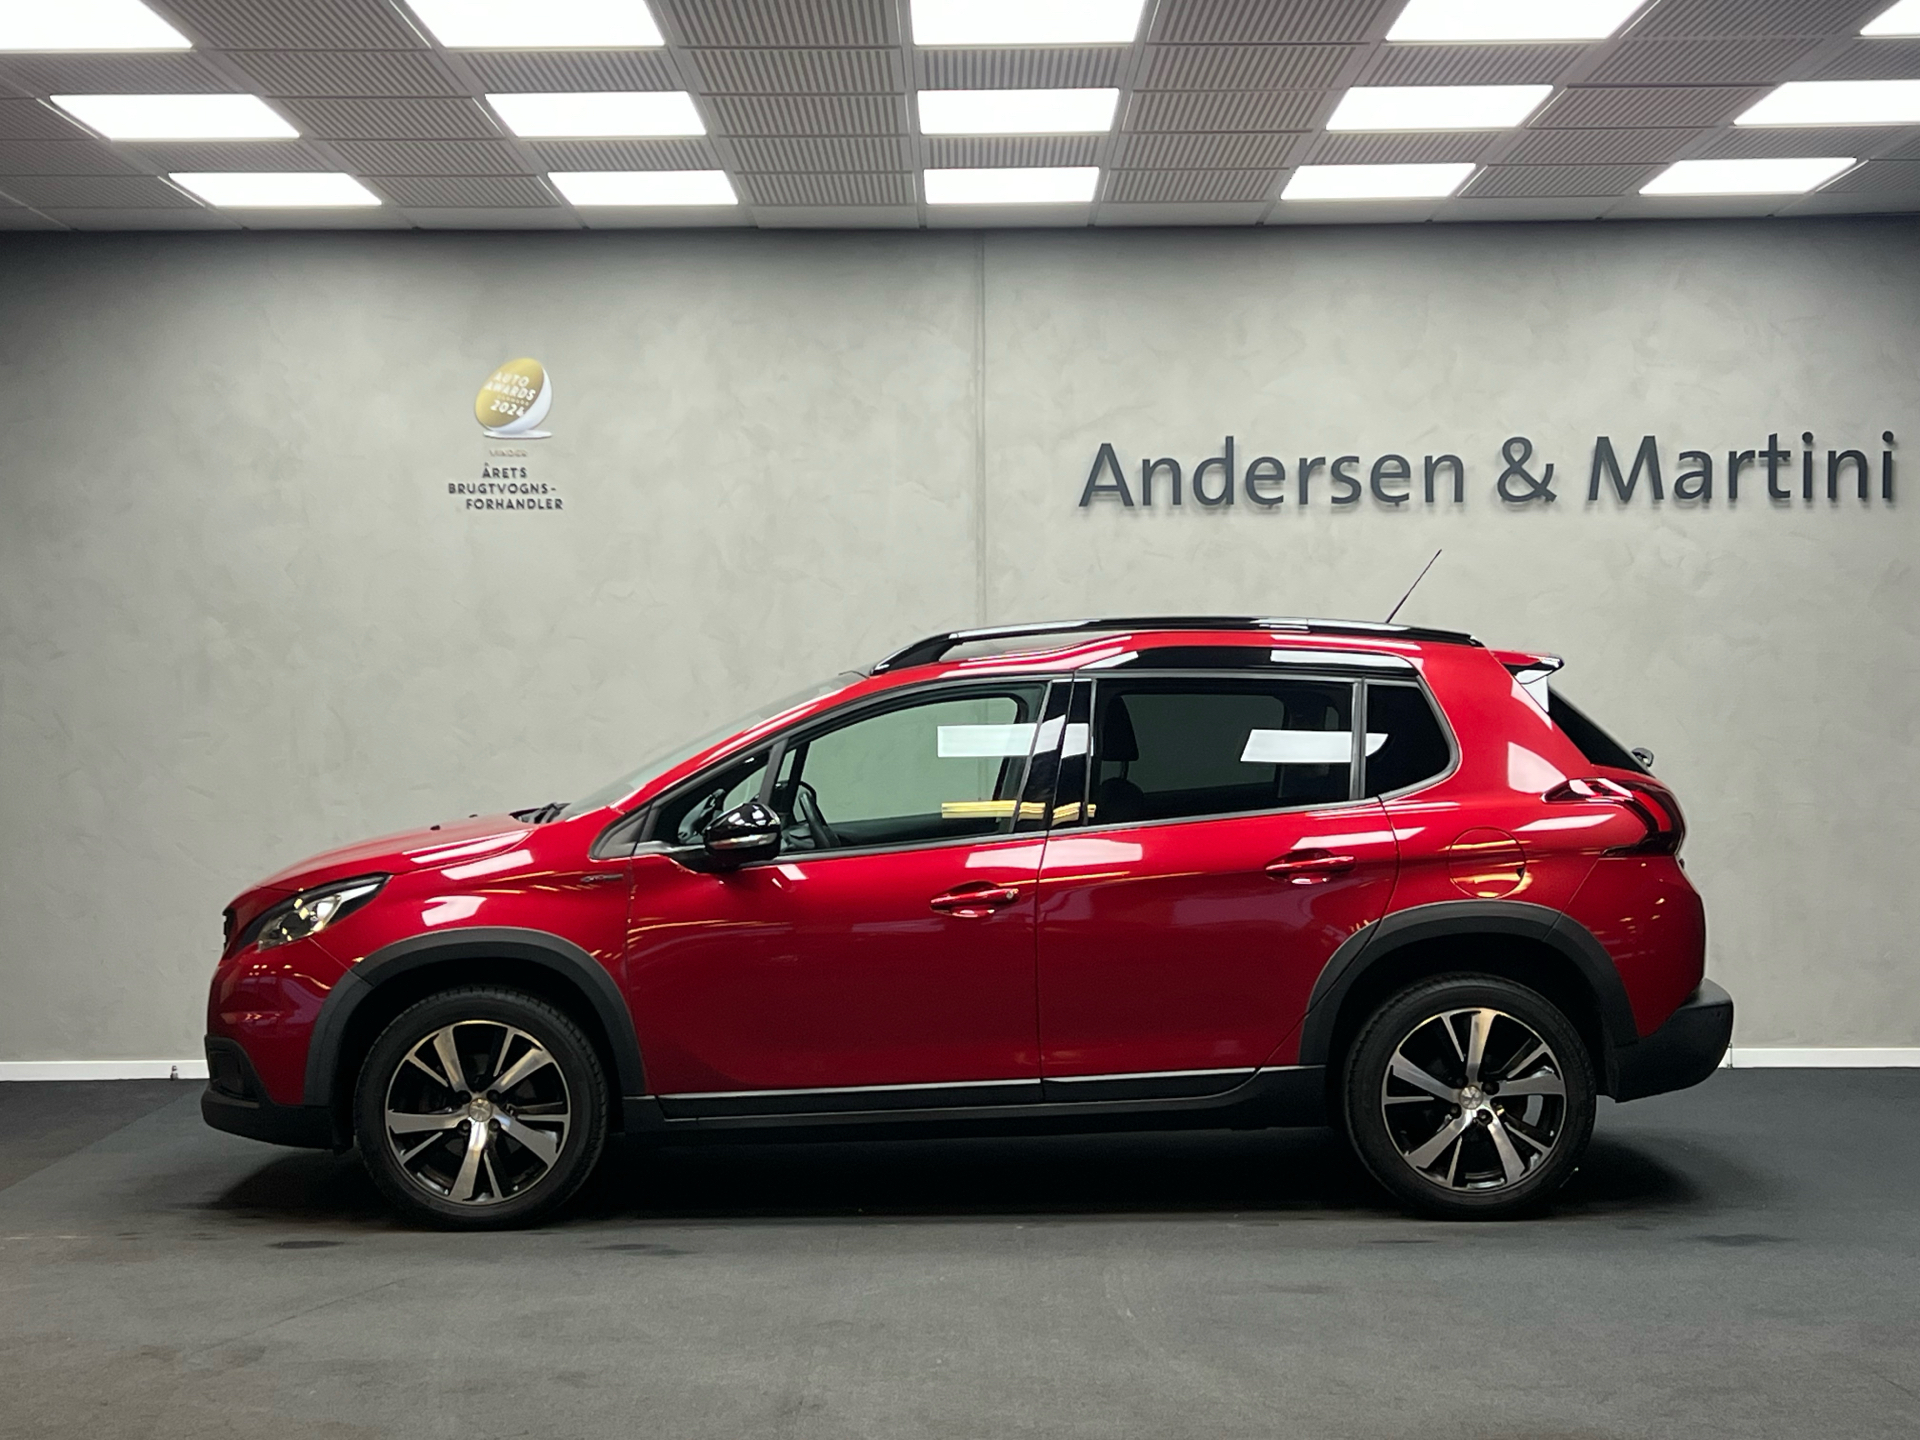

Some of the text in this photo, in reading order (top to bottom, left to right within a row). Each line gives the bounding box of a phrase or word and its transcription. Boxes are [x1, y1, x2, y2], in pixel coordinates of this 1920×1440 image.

[494, 371, 530, 388] AUTO
[483, 381, 536, 401] AWARDS
[490, 399, 525, 417] 2024
[482, 461, 528, 479] ÅRETS
[1078, 430, 1895, 507] Andersen & Martini
[448, 482, 557, 495] BRUGTVOGNS-
[466, 498, 564, 511] FORHANDLER
